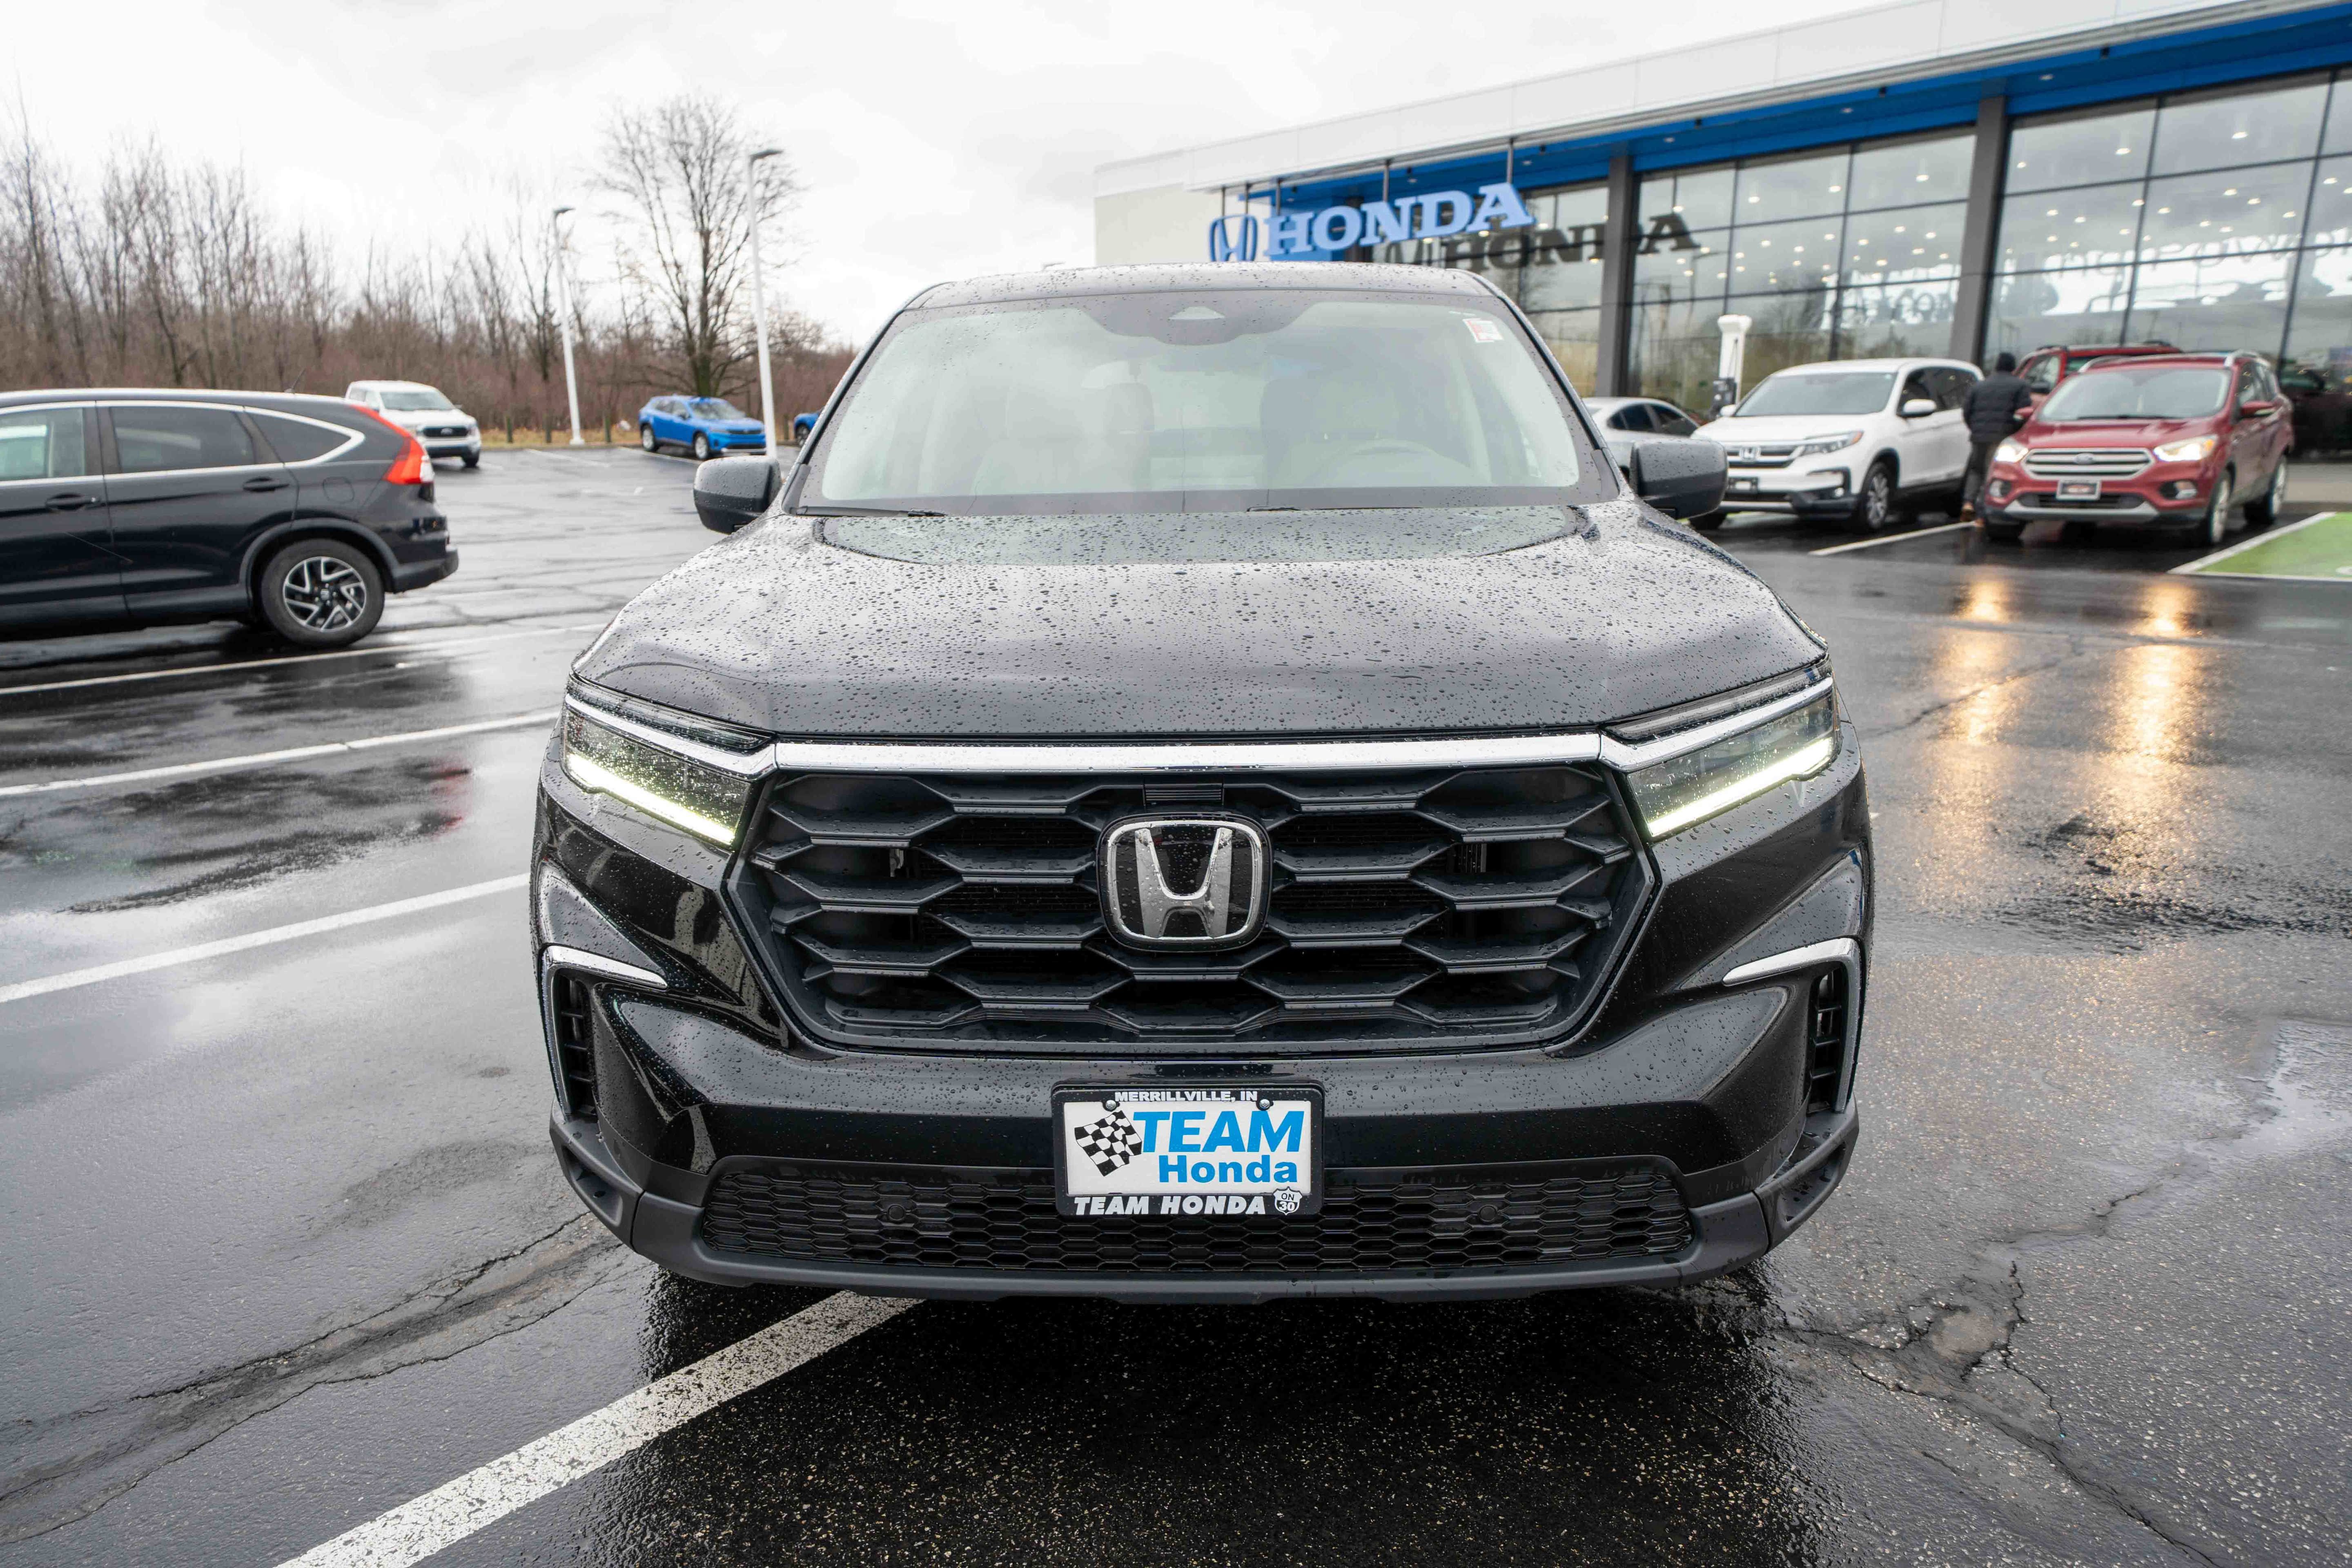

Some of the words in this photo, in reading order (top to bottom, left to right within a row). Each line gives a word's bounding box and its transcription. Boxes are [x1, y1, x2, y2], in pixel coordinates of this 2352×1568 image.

[1263, 181, 1537, 257] HONDA
[1114, 1091, 1236, 1102] MERRILLVILLE,
[1240, 1091, 1258, 1101] IN
[1133, 1110, 1304, 1153] TEAM
[1158, 1154, 1298, 1183] Honda
[1074, 1196, 1149, 1215] TEAM
[1160, 1195, 1266, 1215] HONDA
[1279, 1202, 1295, 1211] 30
